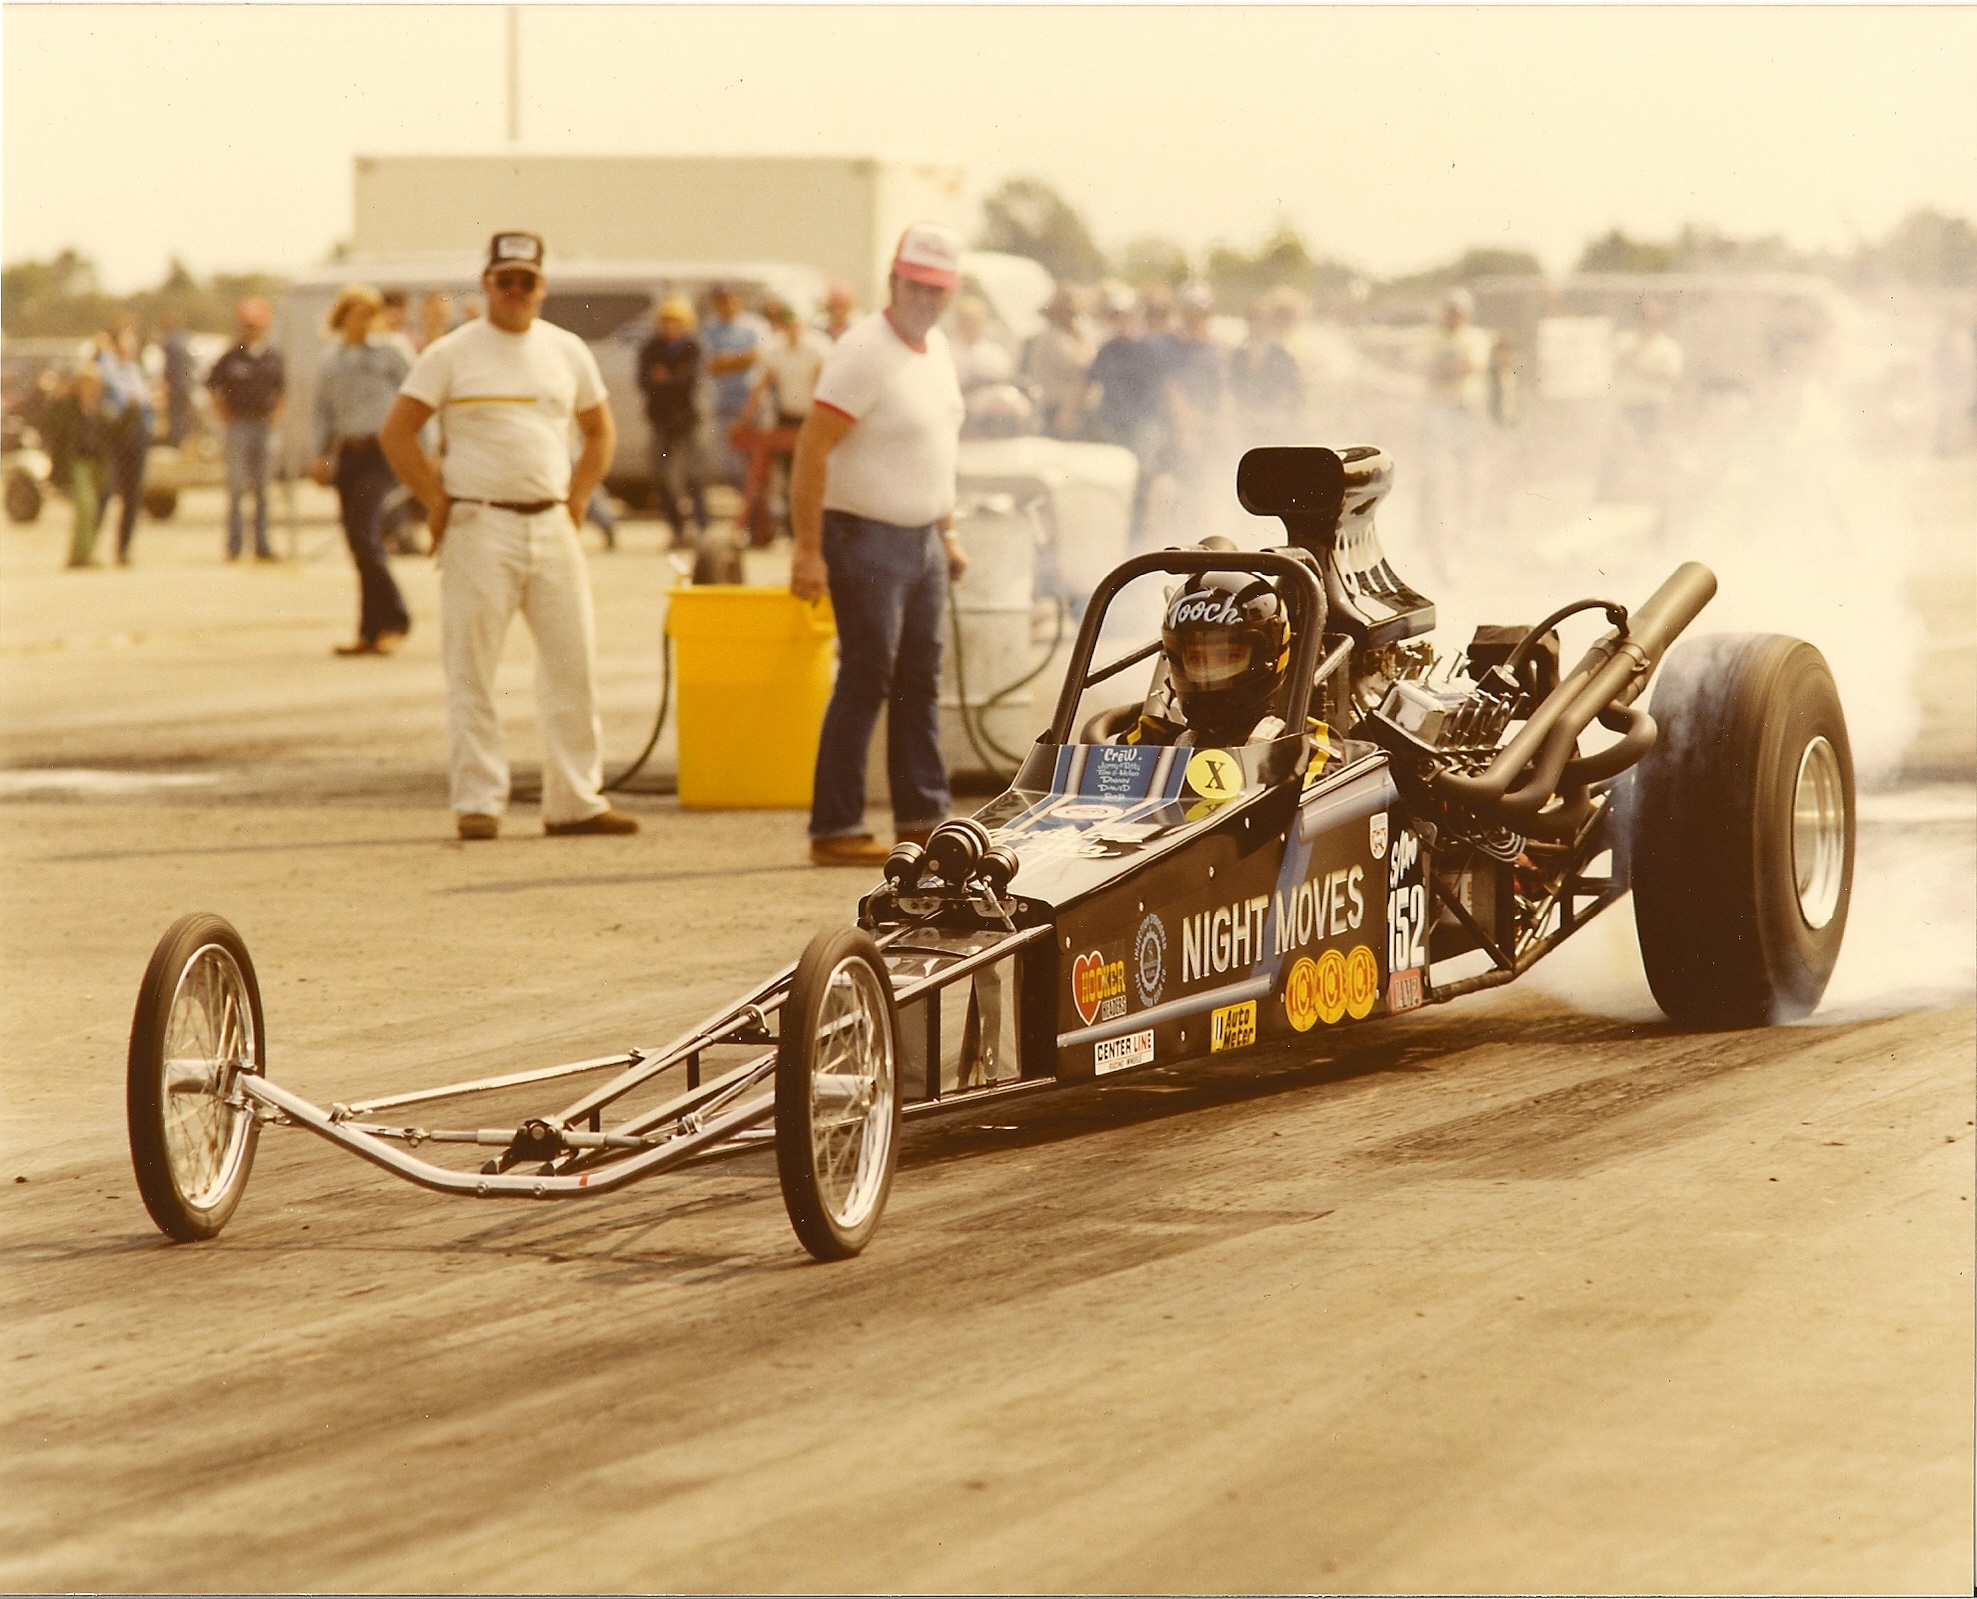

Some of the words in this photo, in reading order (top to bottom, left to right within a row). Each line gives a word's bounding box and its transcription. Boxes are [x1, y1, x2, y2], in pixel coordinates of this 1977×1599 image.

[1168, 589, 1243, 630] Tooch
[1204, 759, 1227, 791] X
[1182, 894, 1269, 983] NIGHT
[1274, 864, 1365, 955] MOVES
[1387, 884, 1425, 973] 152
[1081, 960, 1126, 1004] HOOKER
[1225, 1008, 1250, 1030] Auto
[1097, 1037, 1132, 1062] CENTER
[1133, 1032, 1152, 1053] LINE
[1223, 1026, 1254, 1050] Meter
